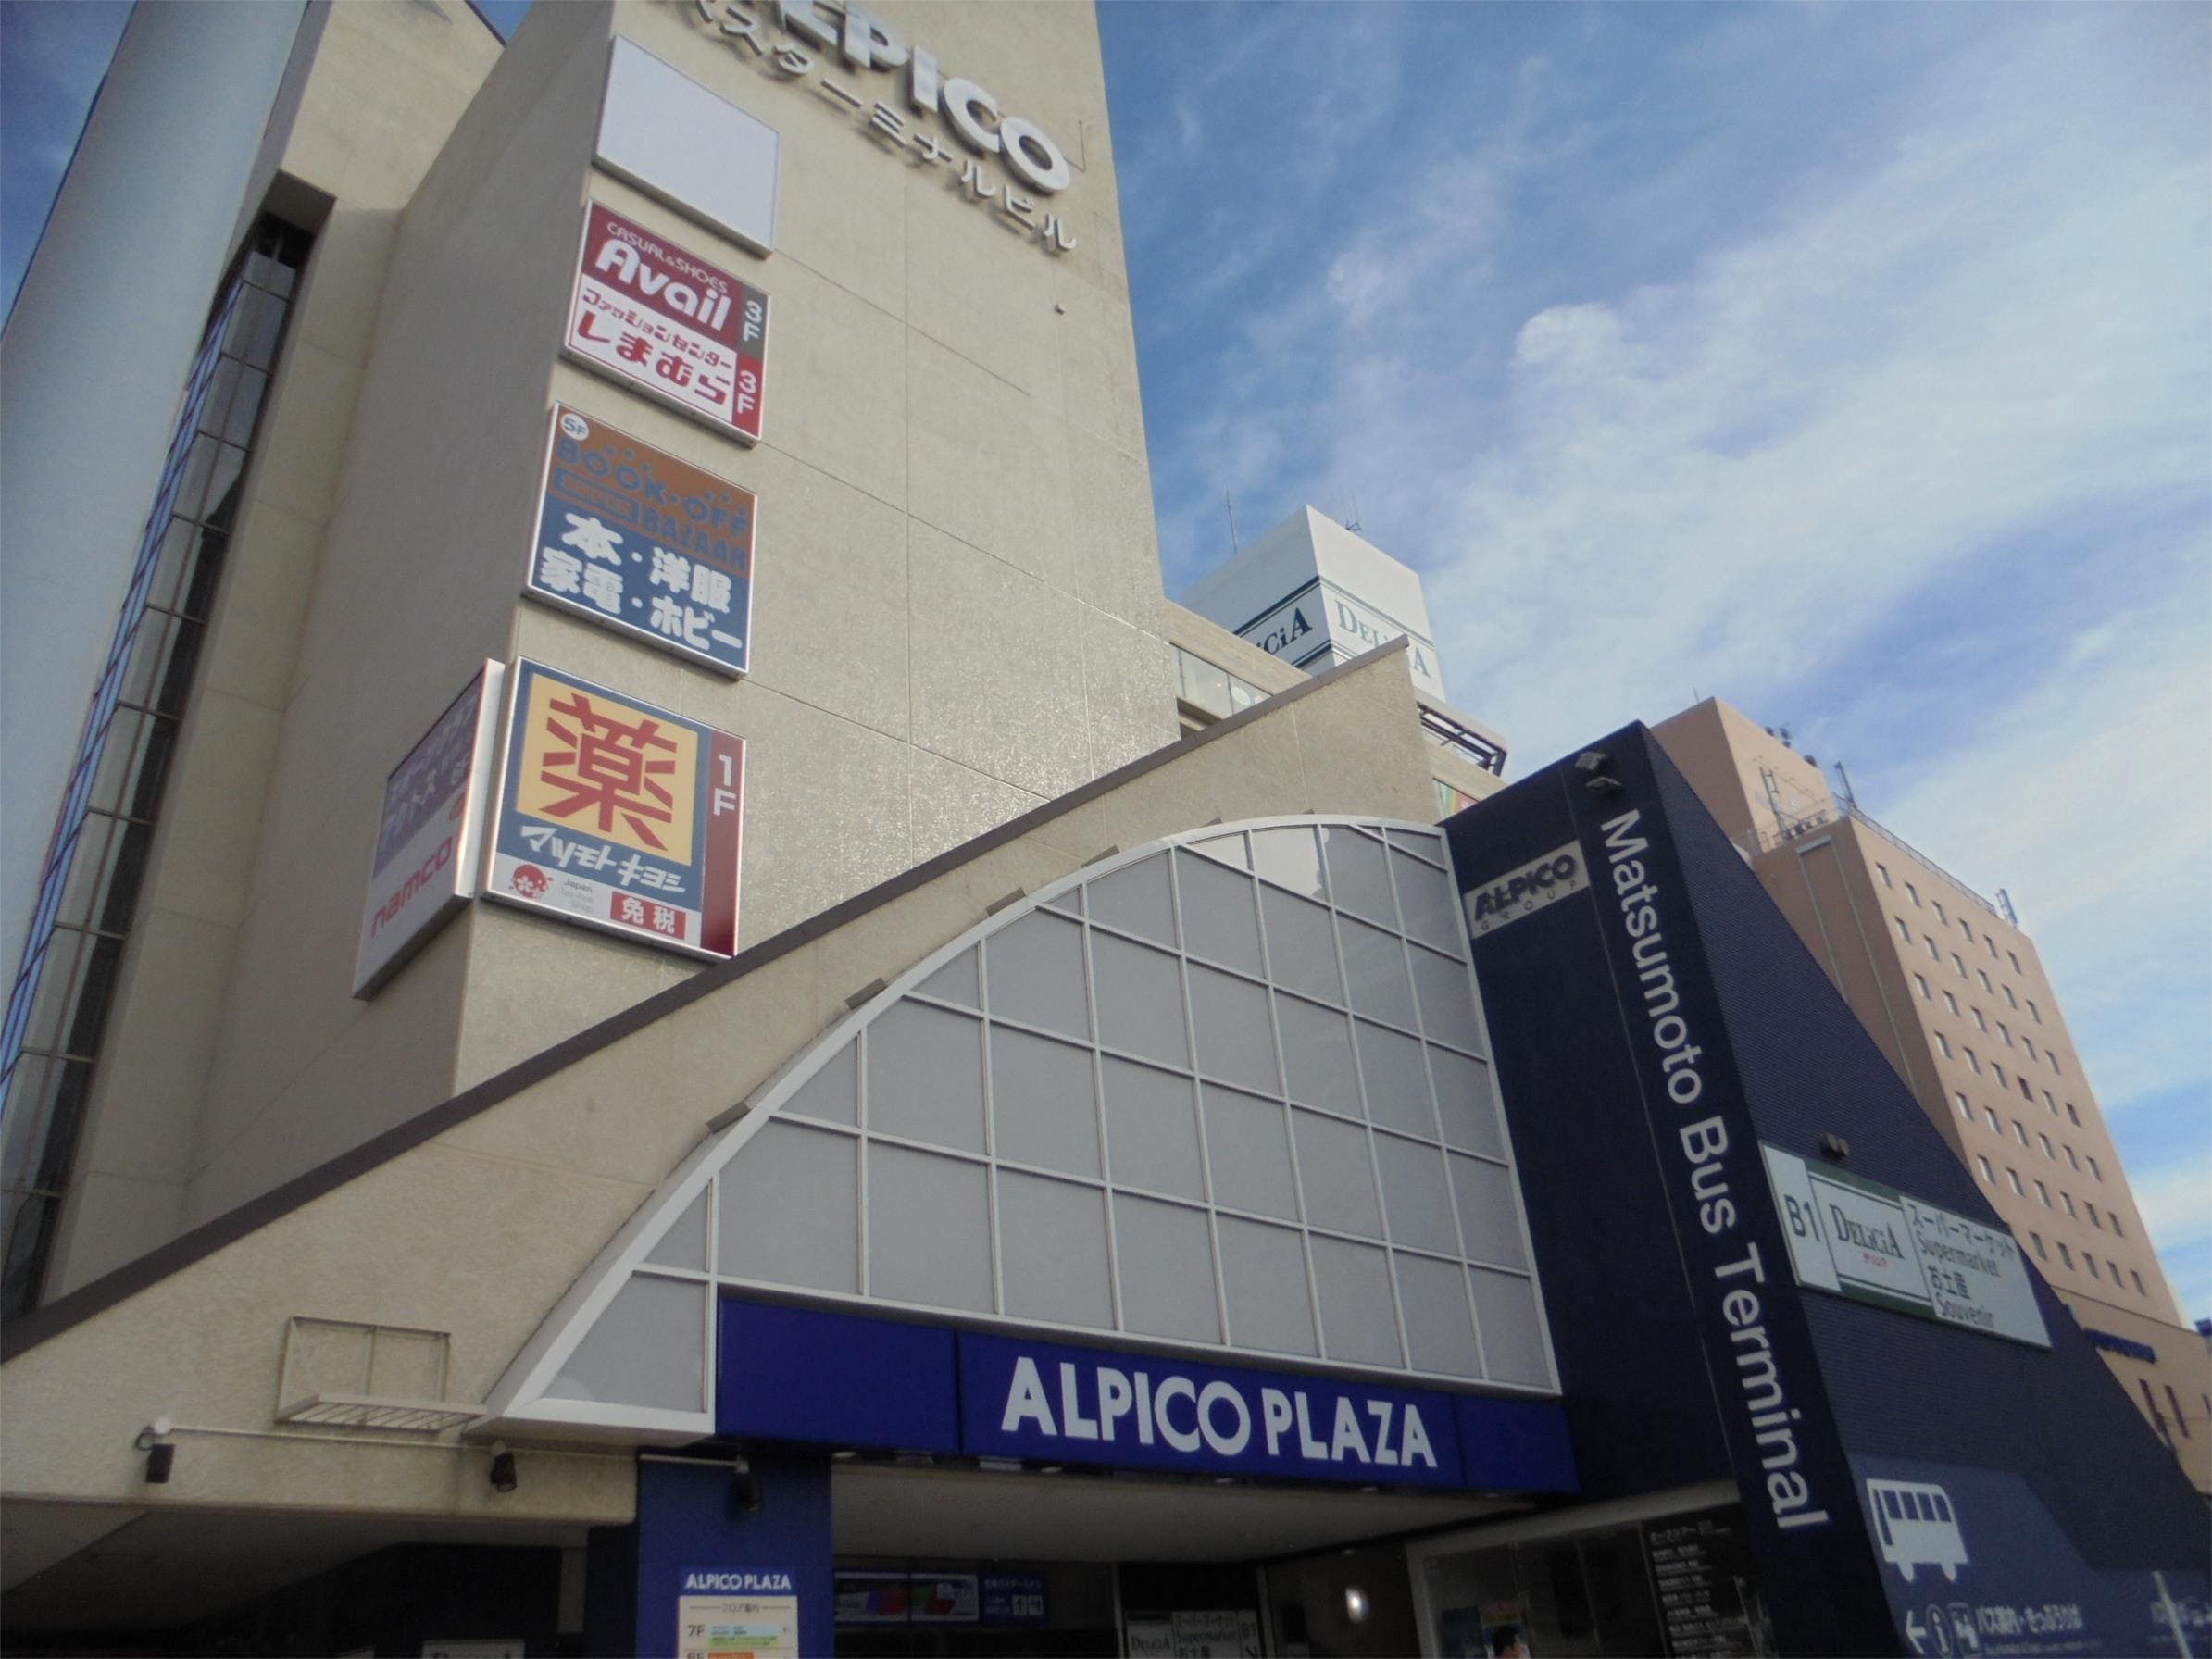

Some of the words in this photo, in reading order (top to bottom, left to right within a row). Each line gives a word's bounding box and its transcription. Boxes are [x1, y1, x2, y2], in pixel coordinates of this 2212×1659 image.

[595, 238, 731, 331] Avail
[577, 310, 731, 405] しまむら
[582, 288, 732, 369] ファッションセンター
[539, 692, 677, 851] 薬
[371, 835, 452, 938] namco
[520, 825, 686, 892] マツモトキヨシ
[1474, 854, 1576, 921] ALPICO
[622, 896, 676, 934] 免税
[1601, 809, 1703, 1104] Matsumoto
[1679, 1116, 1736, 1234] Bus
[1715, 1242, 1829, 1530] Terminal
[1783, 1194, 1820, 1242] B1
[1915, 1230, 2001, 1278] Supermarket
[1934, 1292, 1995, 1329] Souvenir
[1002, 1356, 1251, 1455] ALPICO
[1262, 1388, 1437, 1468] PLAZA
[685, 1573, 742, 1590] ALPICO
[744, 1574, 791, 1590] PLAZA
[687, 1624, 705, 1638] 7F
